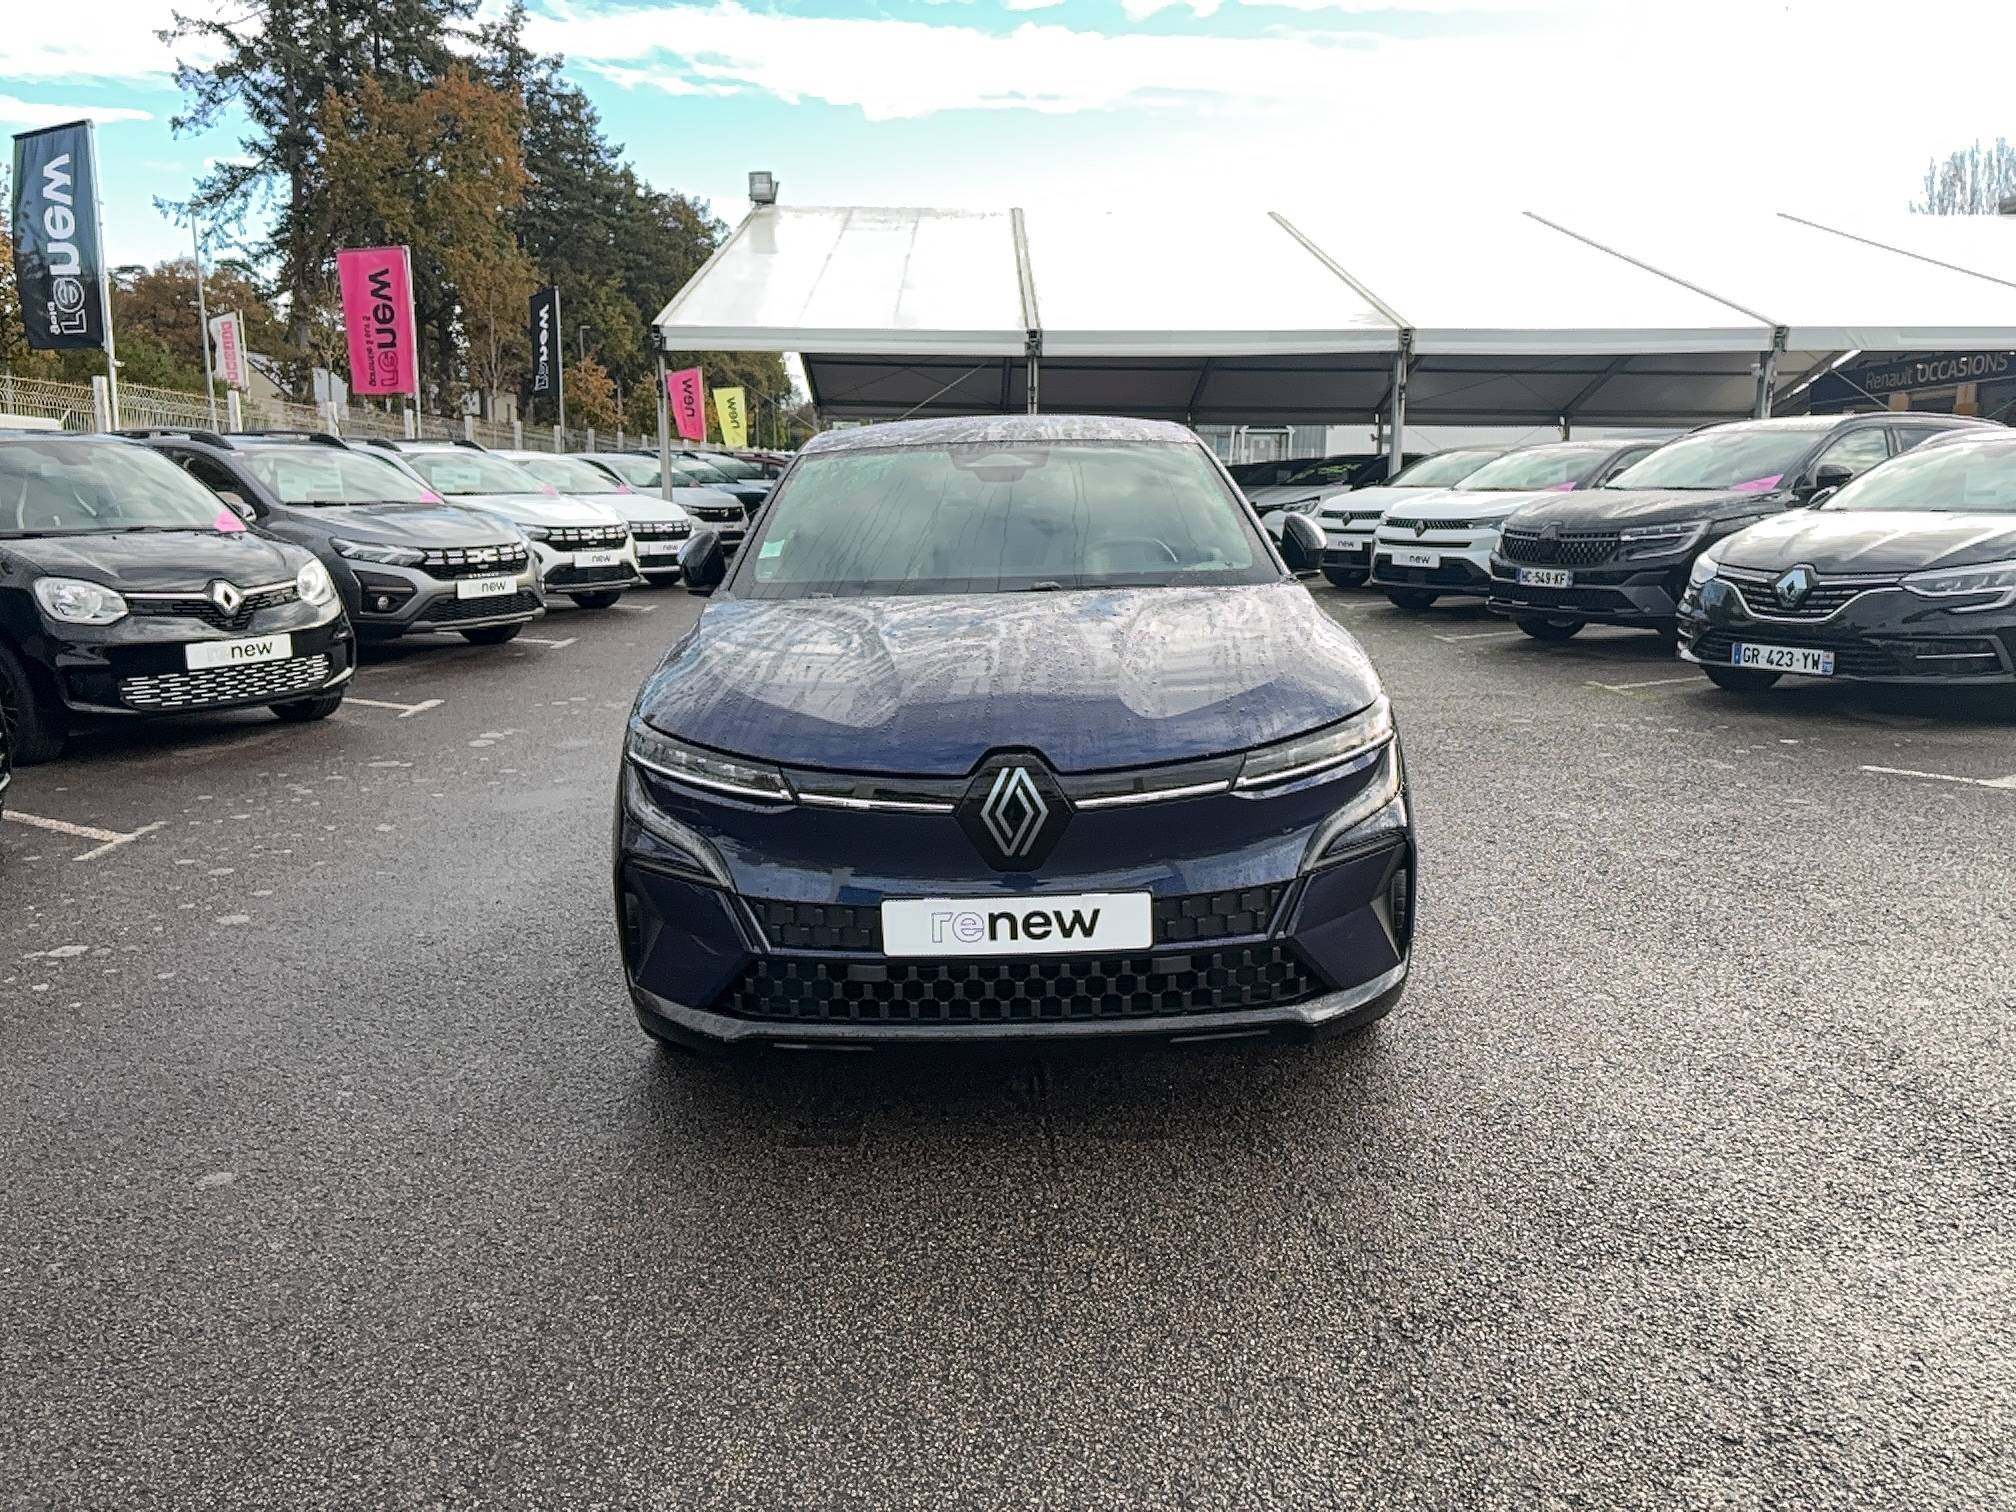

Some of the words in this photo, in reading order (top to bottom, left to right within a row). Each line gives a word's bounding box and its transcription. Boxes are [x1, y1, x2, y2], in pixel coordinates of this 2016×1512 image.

[1865, 366, 1913, 390] Renault
[1917, 352, 2009, 383] OCCASIONS
[931, 908, 1101, 943] renew
